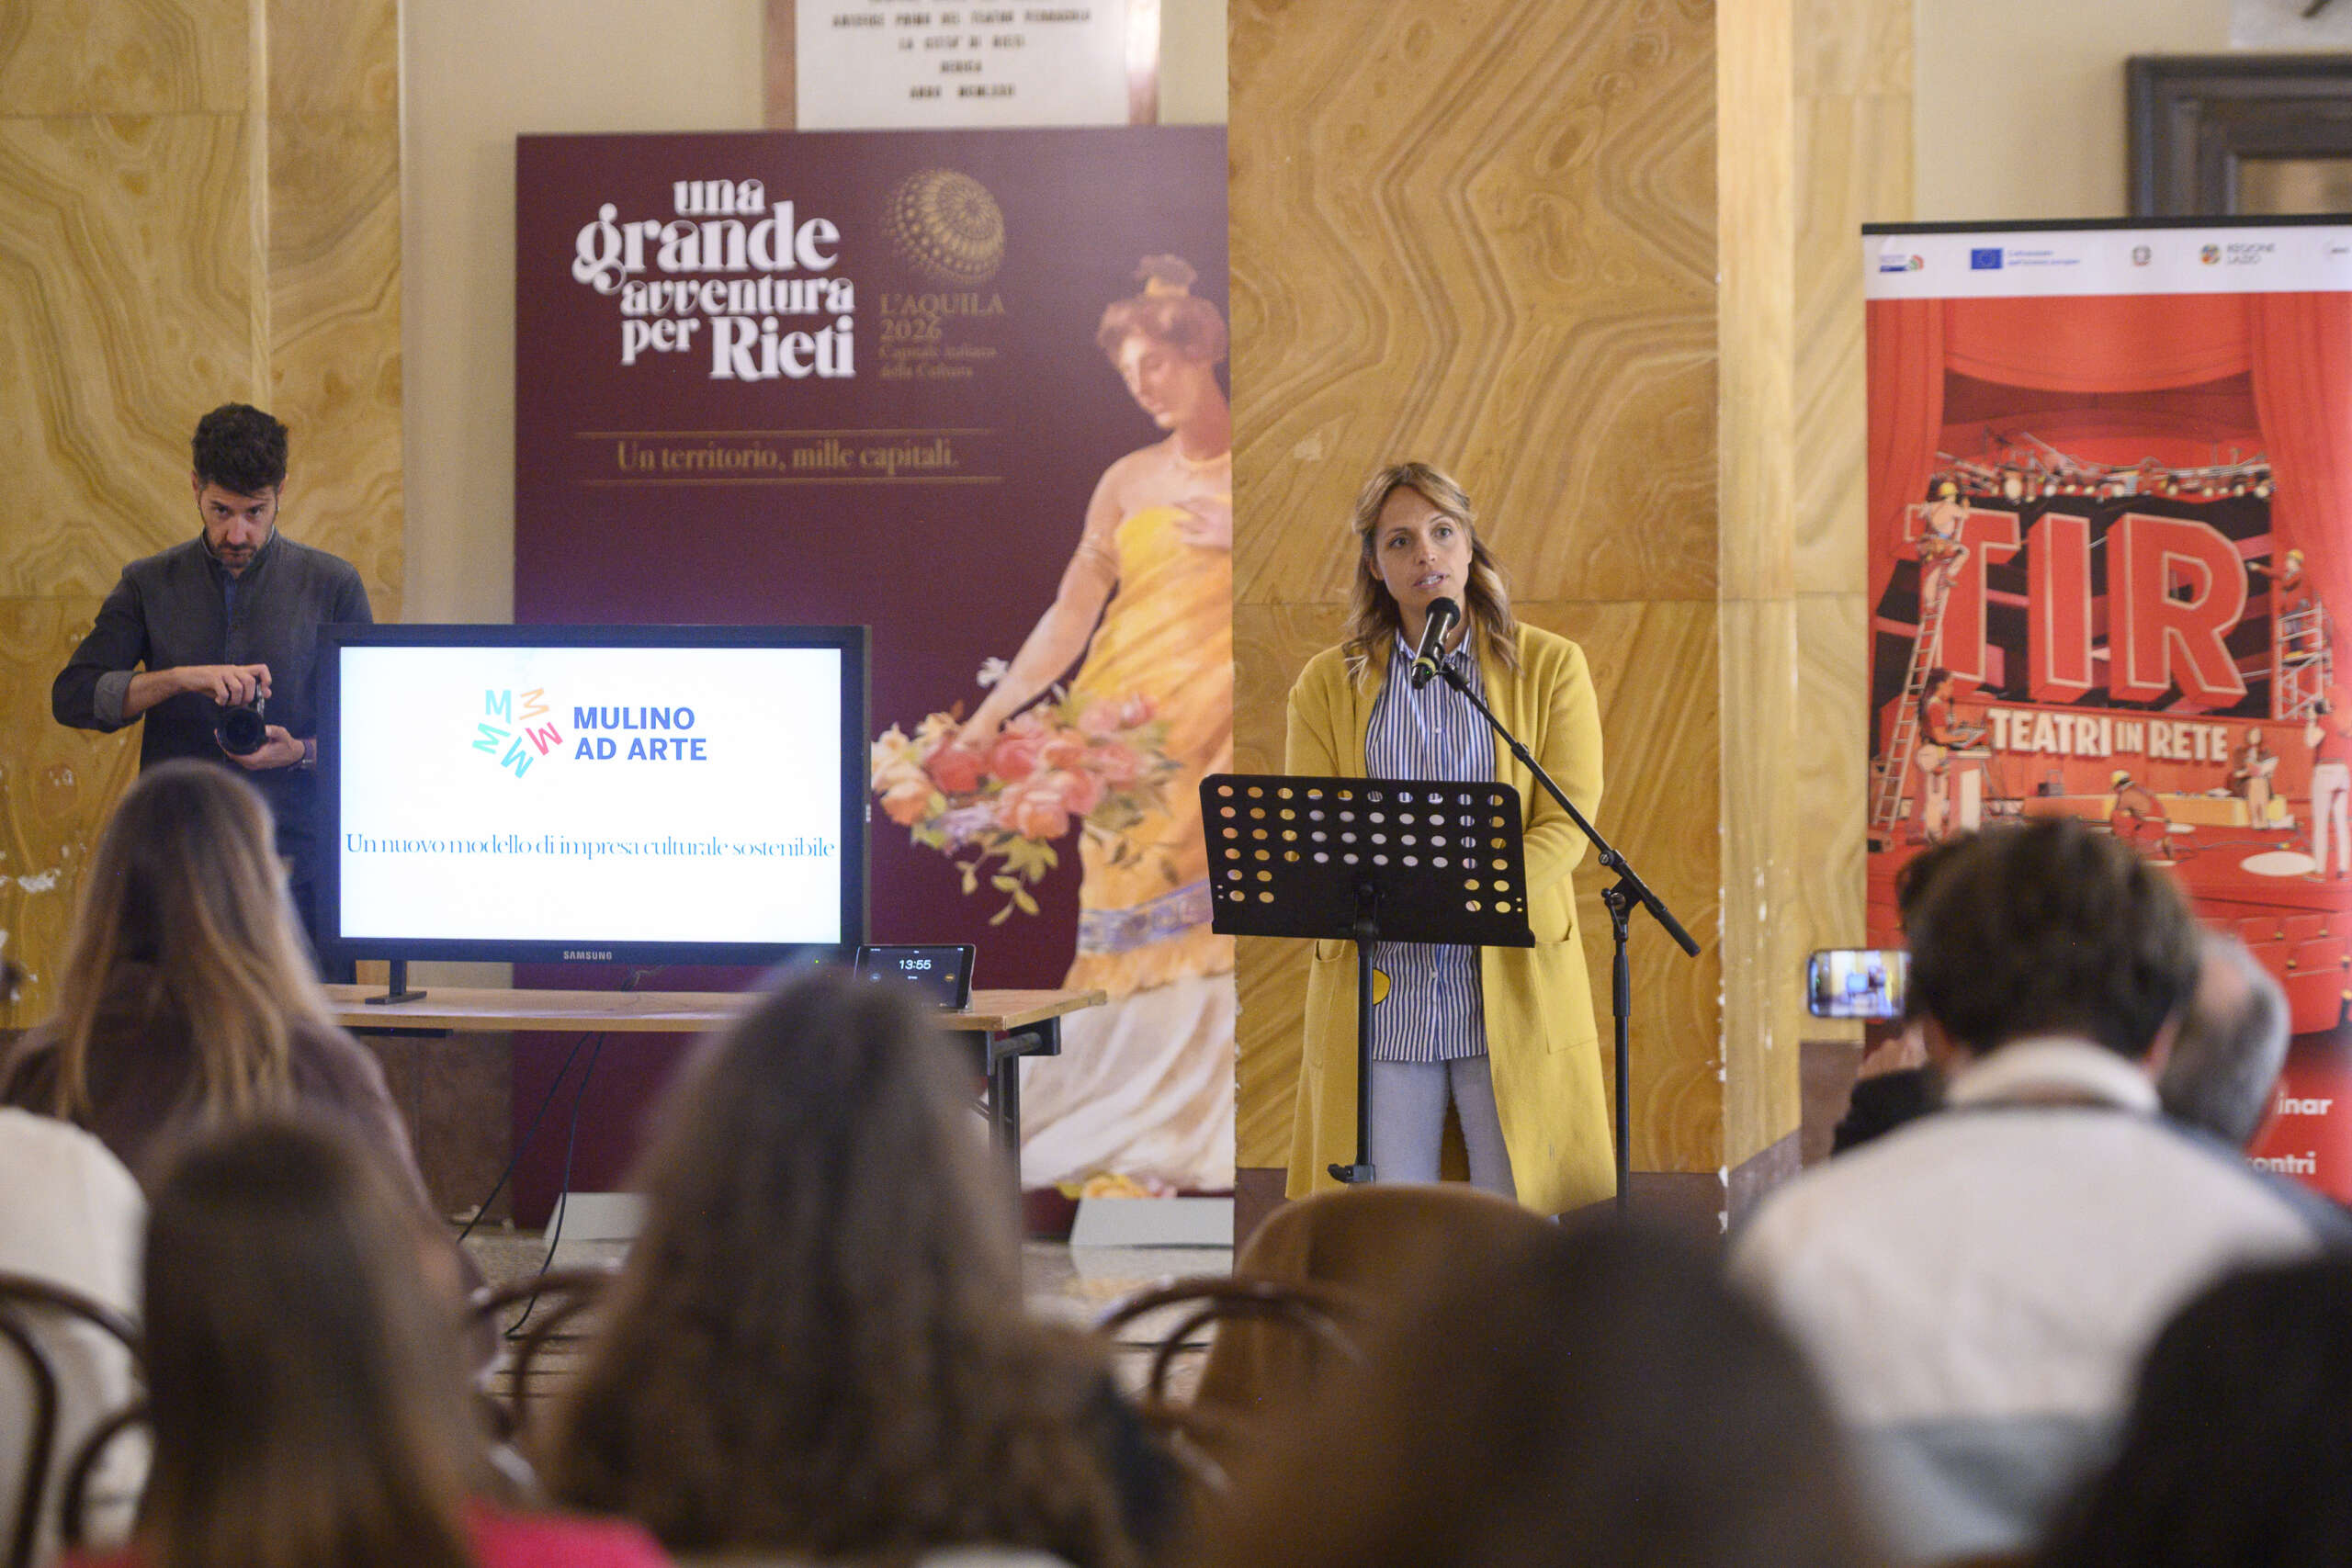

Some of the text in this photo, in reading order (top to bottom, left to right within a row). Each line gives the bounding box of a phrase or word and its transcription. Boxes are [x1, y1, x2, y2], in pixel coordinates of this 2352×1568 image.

[673, 178, 765, 217] una
[571, 199, 840, 295] grande
[620, 274, 855, 317] avventura
[879, 319, 942, 340] 2026
[621, 315, 855, 381] per Rieti
[617, 440, 654, 471] Un
[661, 440, 786, 471] territorio,
[793, 438, 853, 469] mille
[1896, 502, 2248, 707] TIR
[573, 706, 695, 730] MULINO
[1988, 707, 2228, 762] TEATRI IN RETE
[574, 737, 707, 761] AD ARTE
[346, 833, 835, 861] Un nuovo modello di impresa culturale sostenibile
[563, 950, 613, 960] SAMSUNG
[899, 959, 932, 970] 13:55
